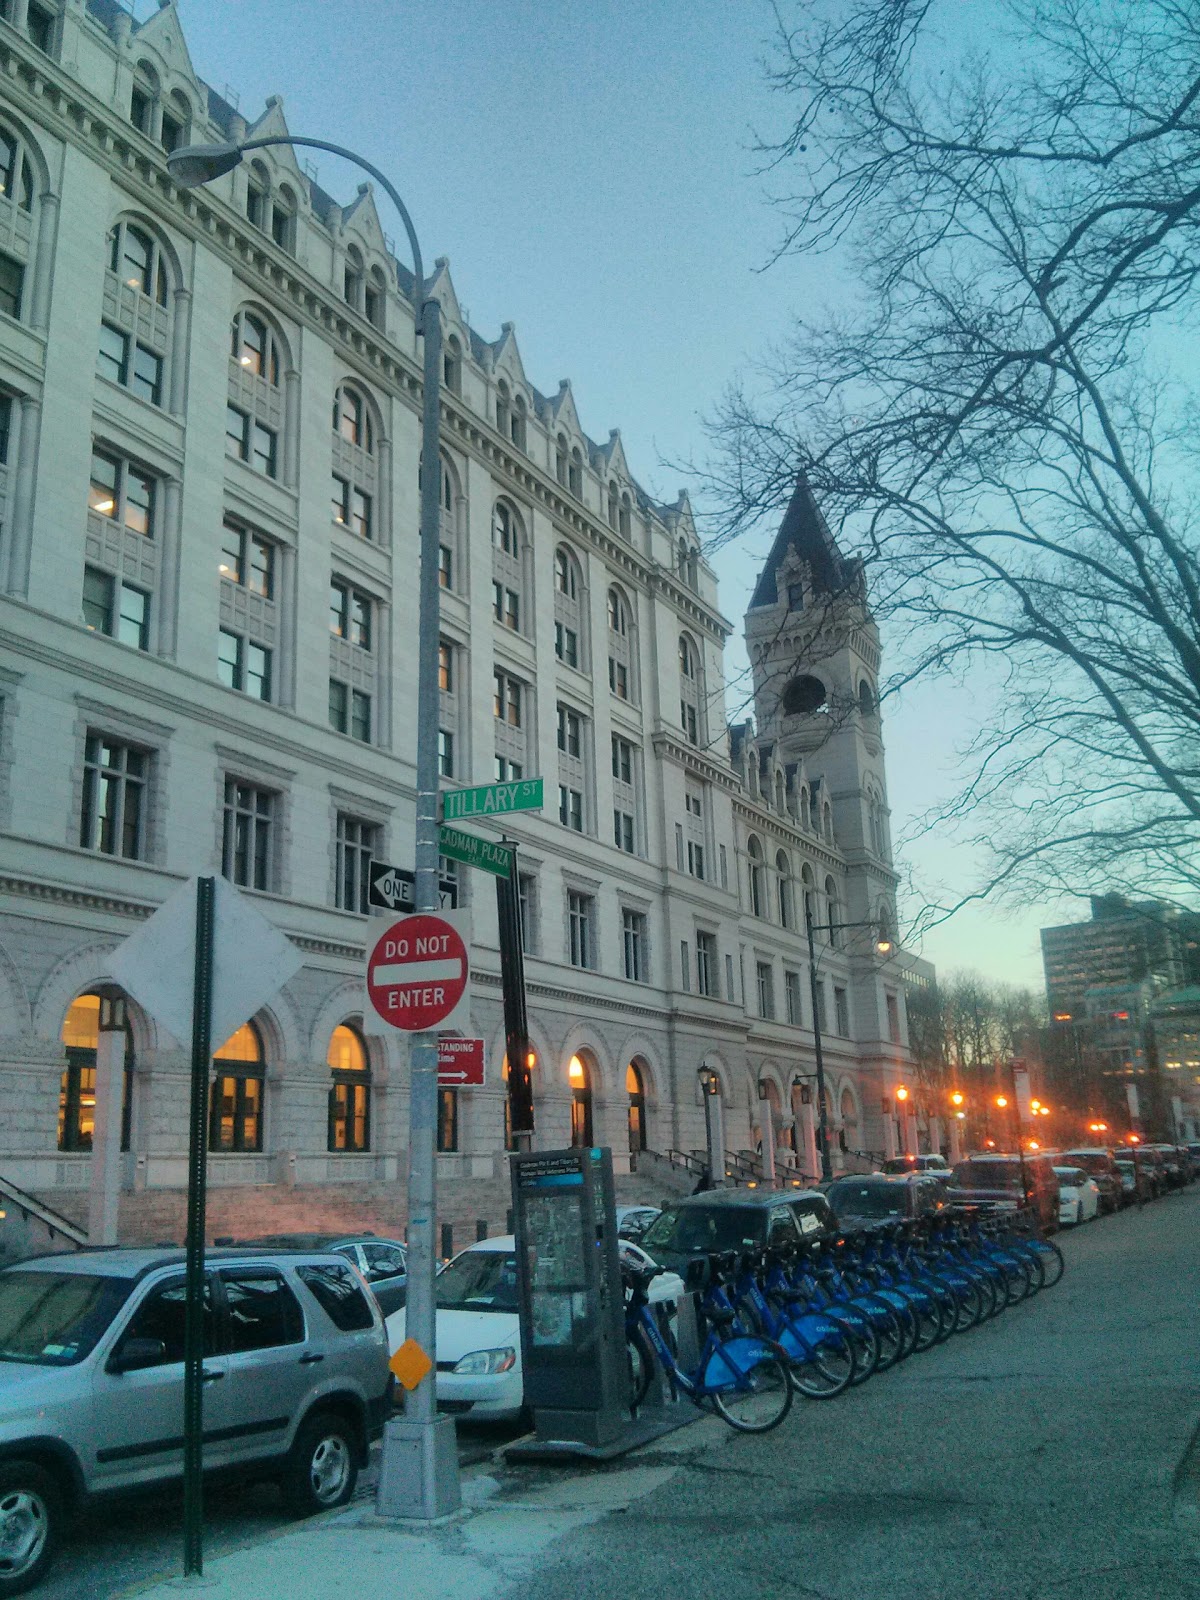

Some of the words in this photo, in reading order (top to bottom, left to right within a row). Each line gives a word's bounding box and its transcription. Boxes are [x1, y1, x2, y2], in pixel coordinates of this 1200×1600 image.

[448, 784, 519, 817] TILLARY
[523, 782, 538, 796] ST
[440, 828, 478, 854] CADMAN
[482, 844, 509, 867] PLAZA
[383, 878, 409, 900] ONE
[385, 939, 409, 958] DO
[416, 935, 450, 955] NOT
[388, 987, 445, 1009] ENTER
